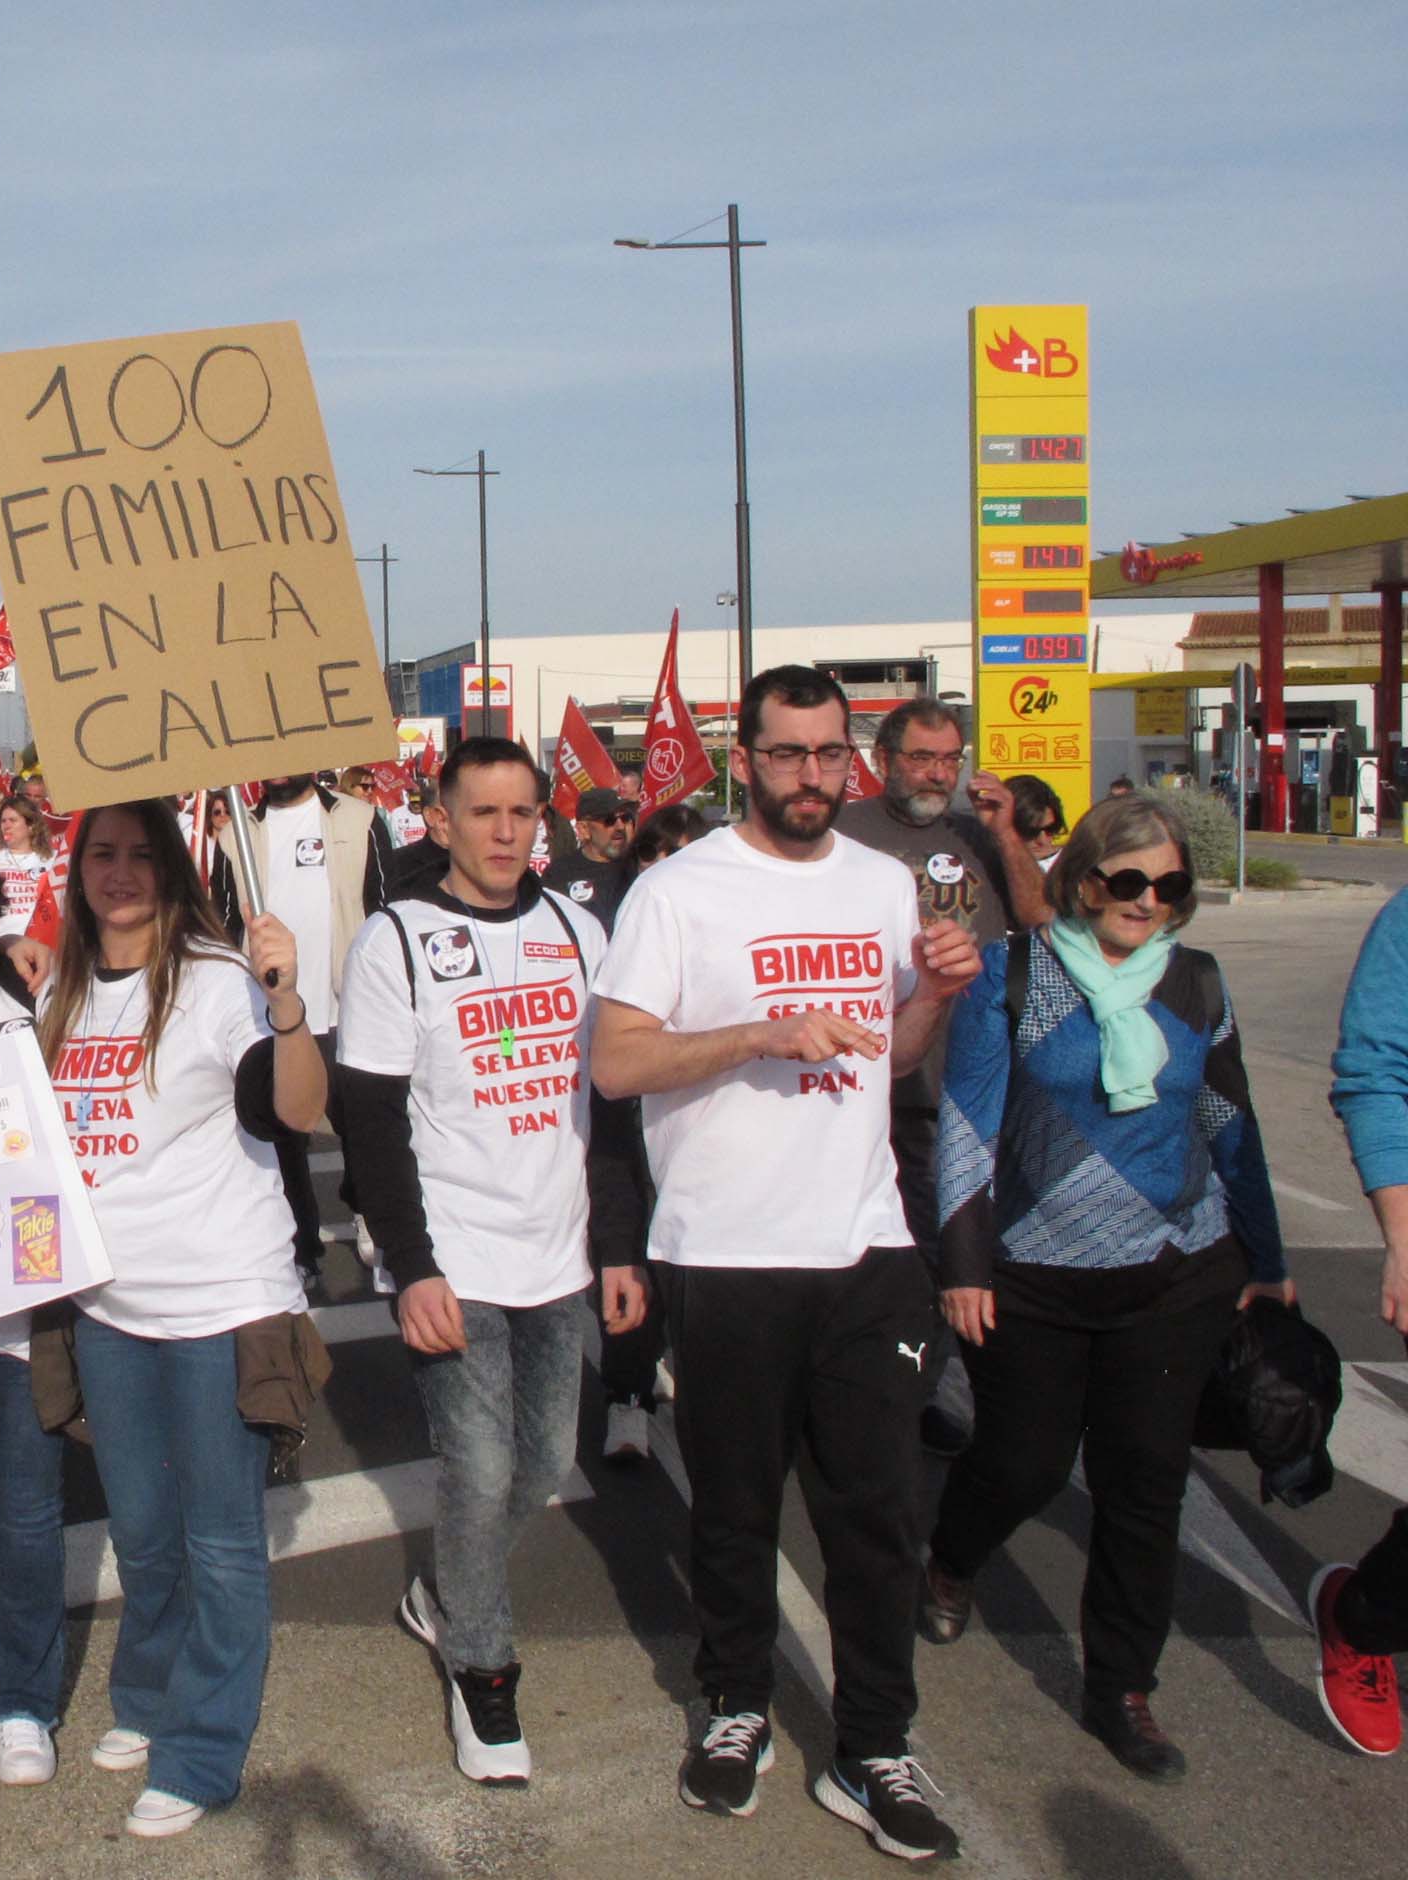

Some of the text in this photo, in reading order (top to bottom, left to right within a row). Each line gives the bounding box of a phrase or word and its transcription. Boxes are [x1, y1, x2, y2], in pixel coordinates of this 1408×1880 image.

[26, 343, 272, 463] 100
[40, 571, 320, 683] EN LA
[74, 660, 373, 771] CALLE
[1019, 690, 1058, 714] 24h
[751, 941, 883, 985] BIMBO
[457, 986, 577, 1039] BIMBO
[52, 1043, 145, 1081] IMBO
[472, 1054, 502, 1076] SE
[799, 1070, 864, 1094] PAN.
[16, 1209, 55, 1246] Takis
